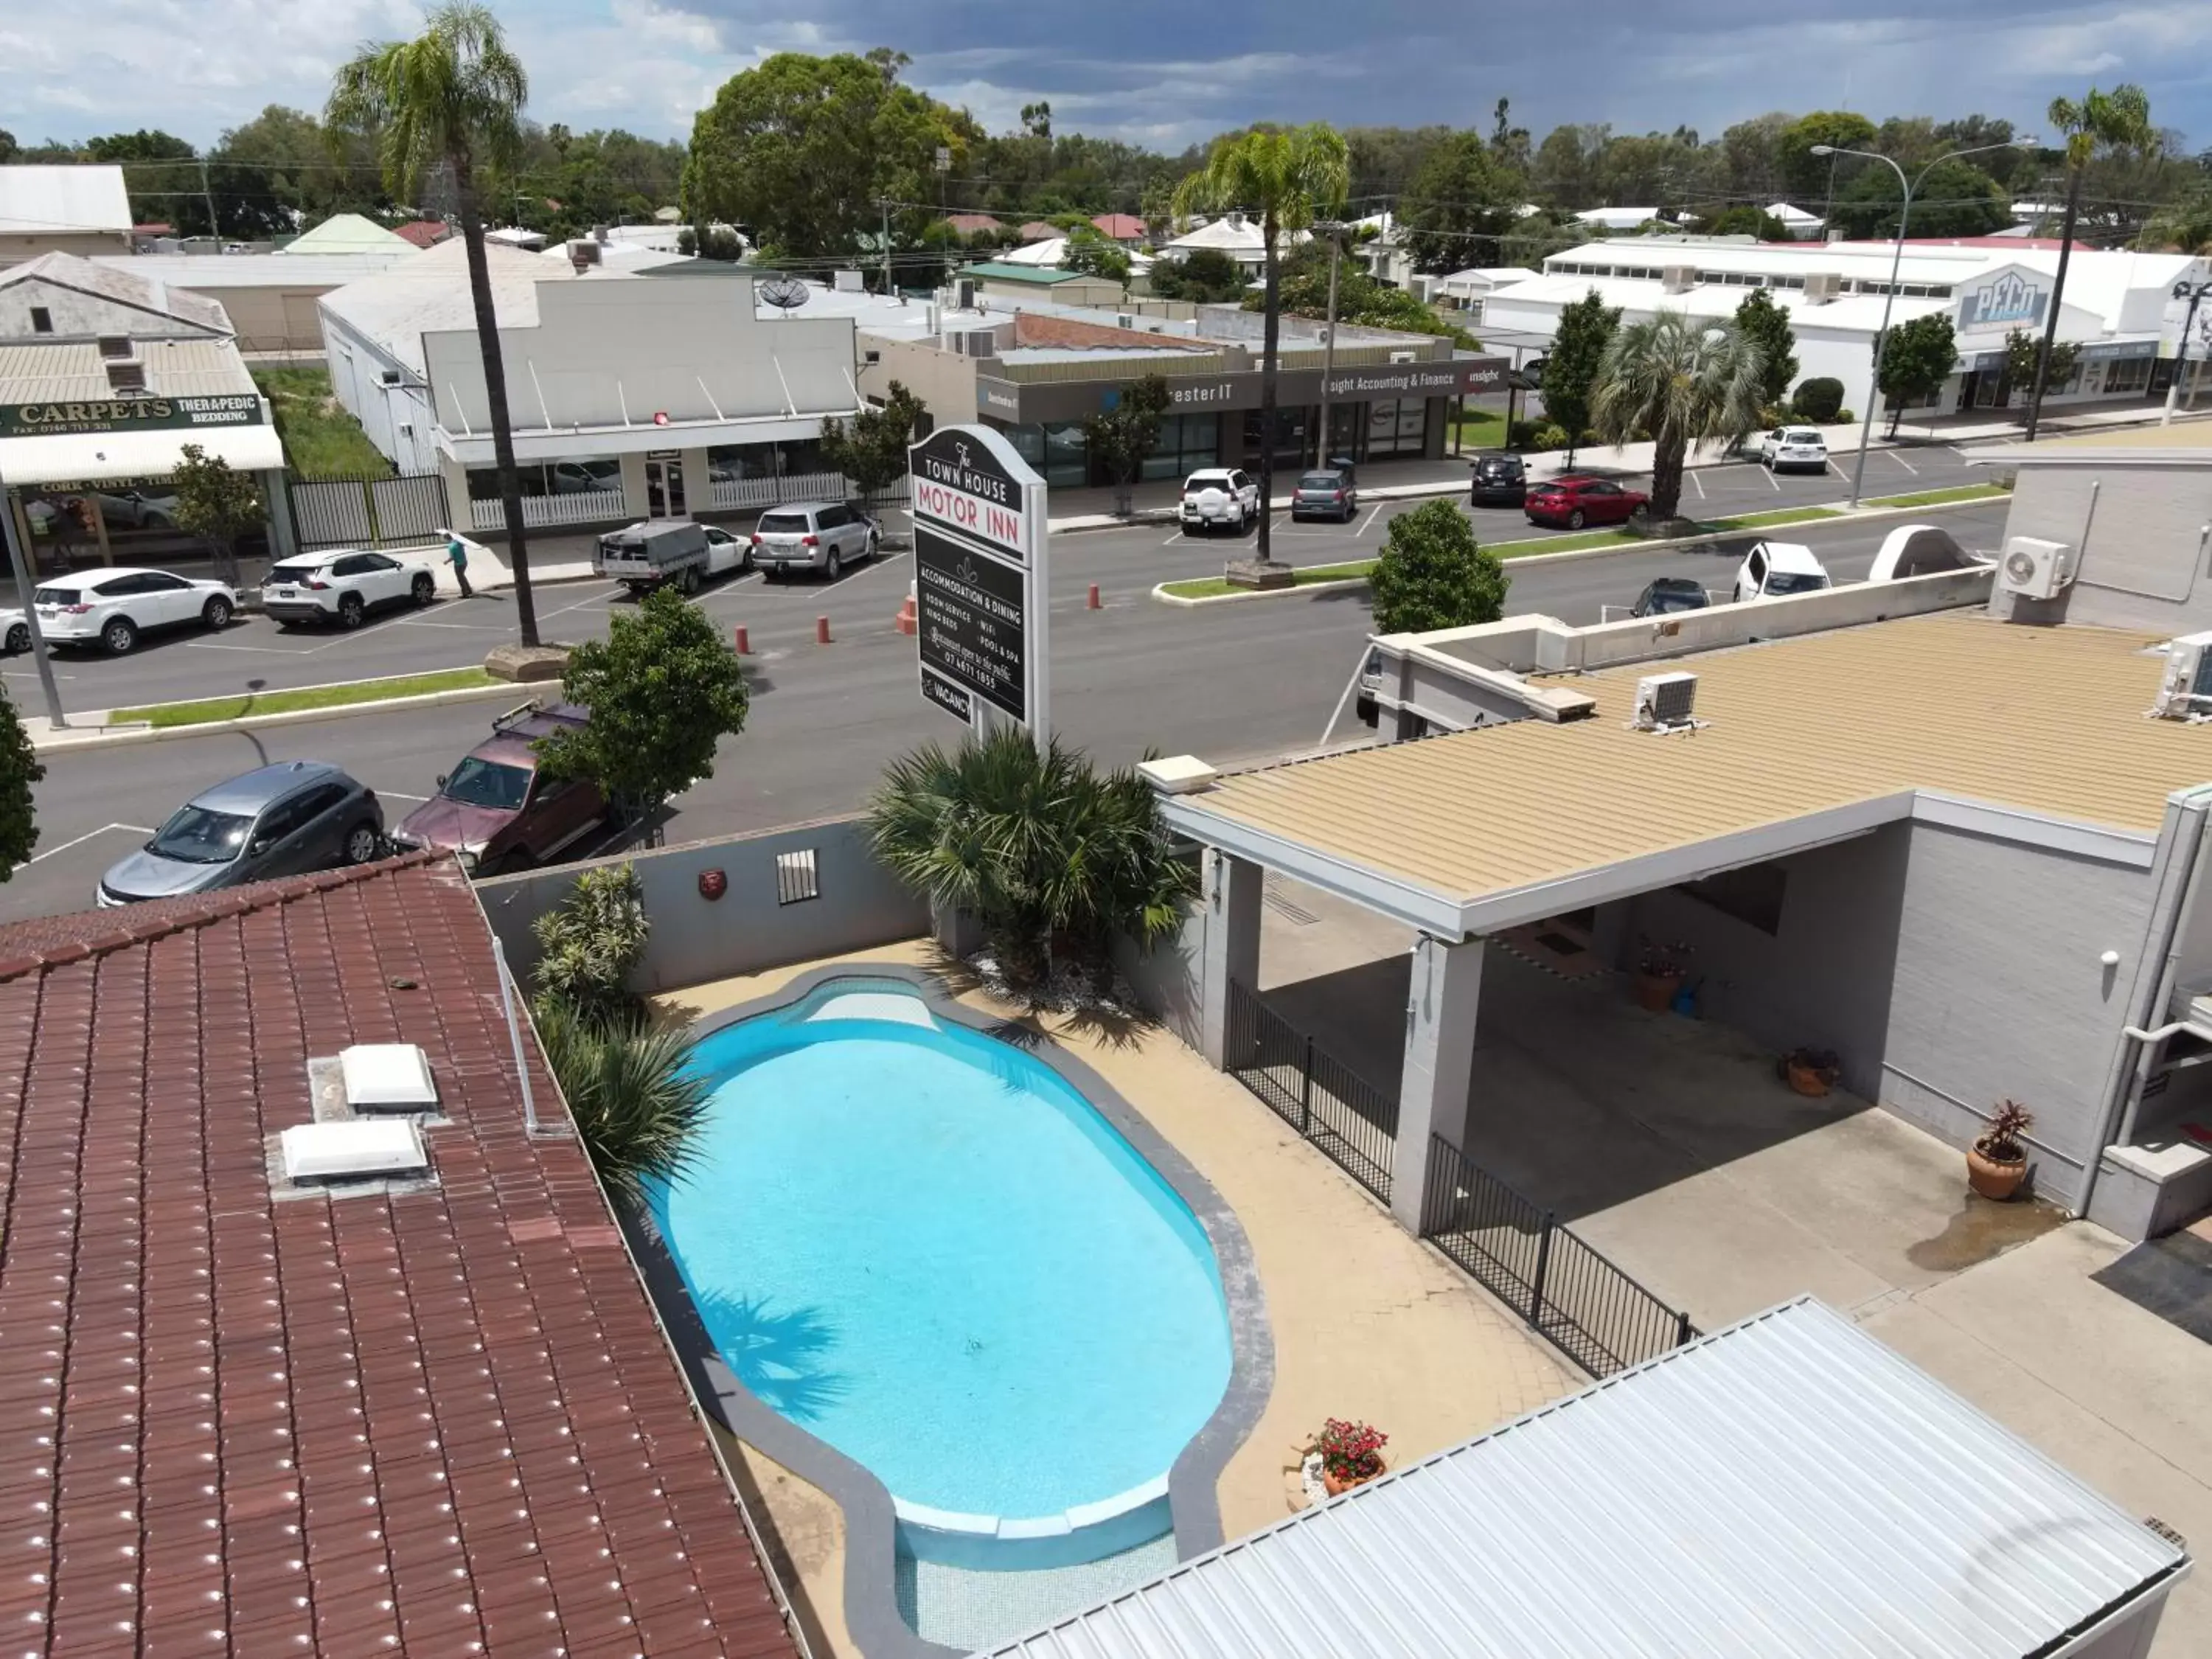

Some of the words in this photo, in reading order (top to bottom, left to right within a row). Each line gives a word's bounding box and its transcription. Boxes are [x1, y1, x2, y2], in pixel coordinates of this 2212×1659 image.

[1357, 375, 1408, 390] Accounting
[1411, 373, 1418, 387] &
[1420, 372, 1455, 386] Finance
[1470, 369, 1499, 383] insight
[19, 400, 173, 424] CARPETS
[178, 397, 256, 412] THERAPEDIC
[192, 411, 248, 422] BEDDING
[956, 442, 971, 472] The
[41, 481, 83, 493] CORK
[91, 478, 136, 489] VINYL
[925, 459, 961, 486] TOWN
[965, 471, 1006, 503] HOUSE
[919, 483, 978, 529] MOTOR
[987, 507, 1018, 545] INN
[921, 566, 983, 605] ACCOMMODATION
[985, 597, 990, 610] &
[992, 601, 1021, 625] DINING
[945, 651, 954, 664] 07
[935, 681, 970, 716] VACANCY
